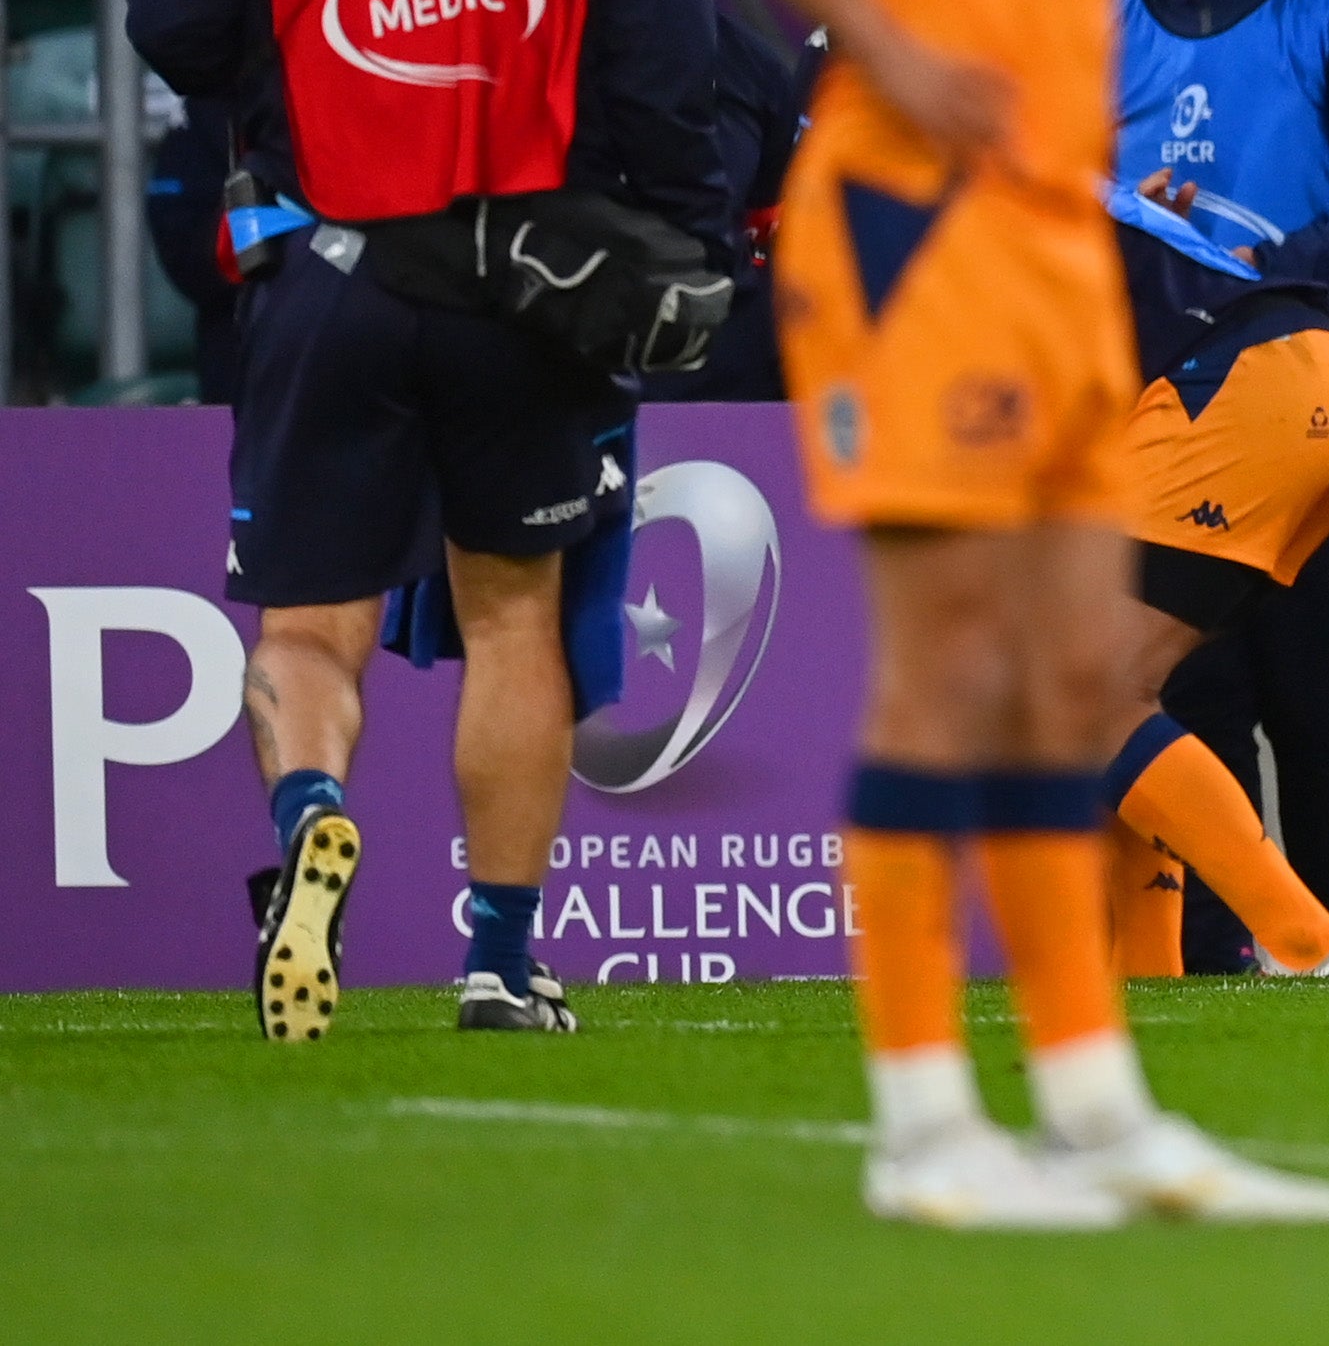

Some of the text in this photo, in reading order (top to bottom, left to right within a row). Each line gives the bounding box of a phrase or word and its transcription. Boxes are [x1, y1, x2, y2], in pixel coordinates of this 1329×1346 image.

[1161, 140, 1215, 164] EPCR
[450, 833, 844, 869] EOPEAN RUGB
